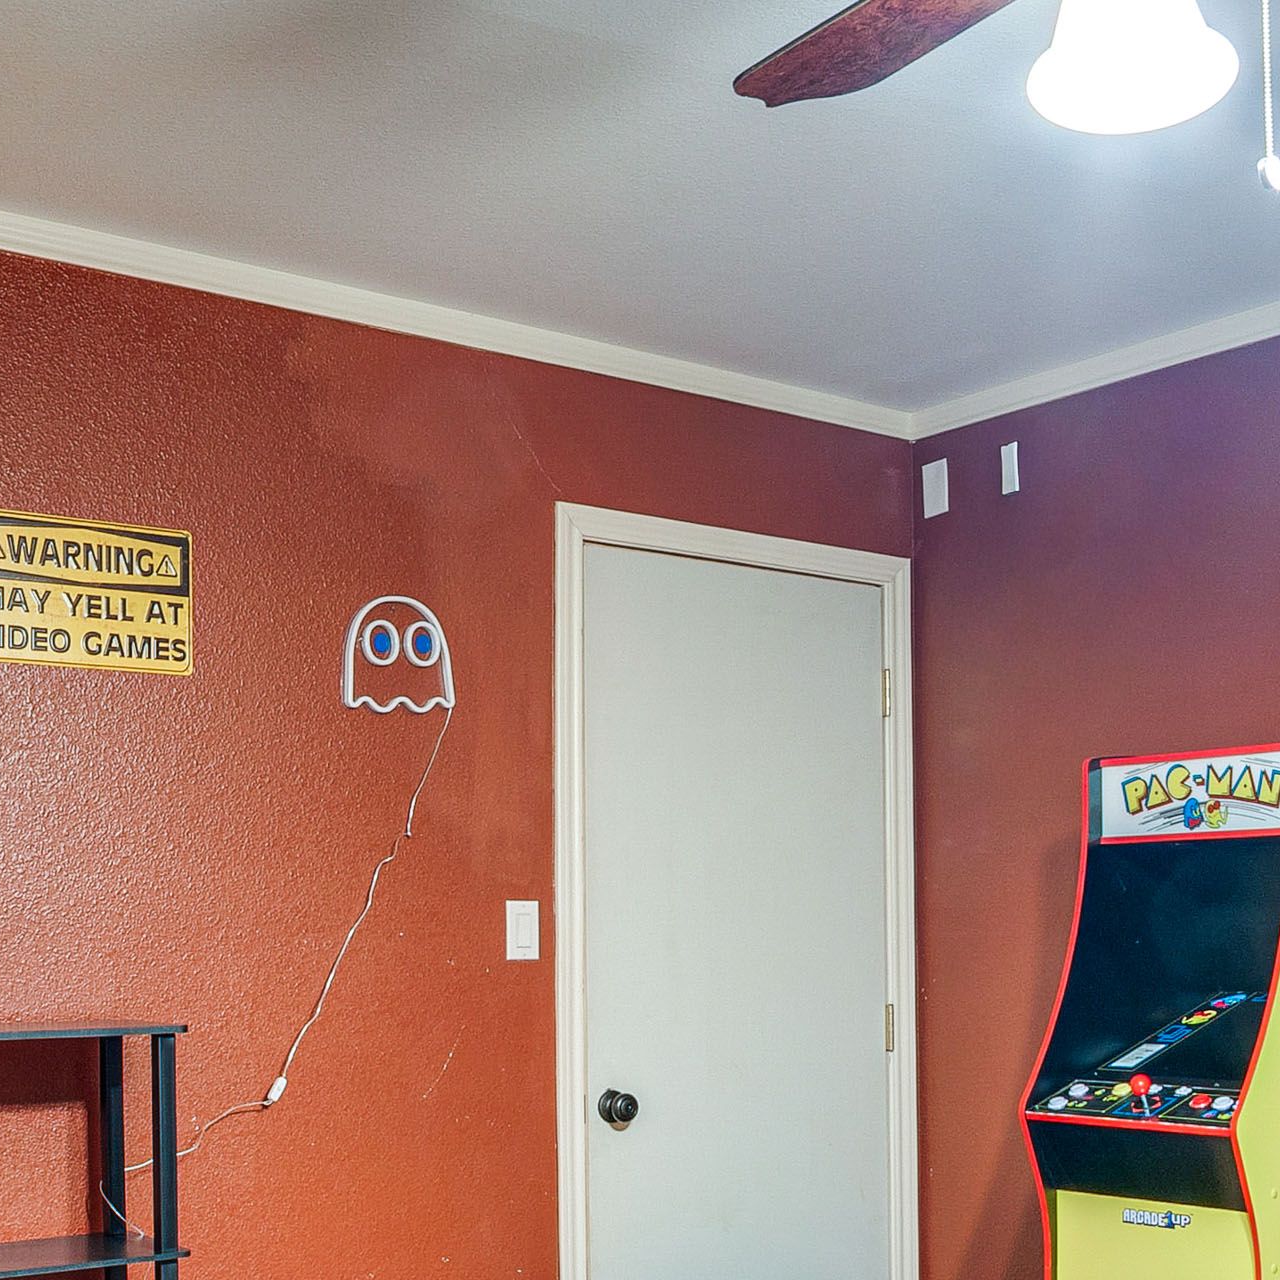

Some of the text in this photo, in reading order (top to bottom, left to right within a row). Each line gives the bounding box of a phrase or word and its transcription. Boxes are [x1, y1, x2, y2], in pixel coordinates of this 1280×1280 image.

[7, 534, 155, 577] WARNING
[63, 592, 134, 622] YELL
[145, 600, 183, 625] AT
[81, 631, 186, 662] GAMES
